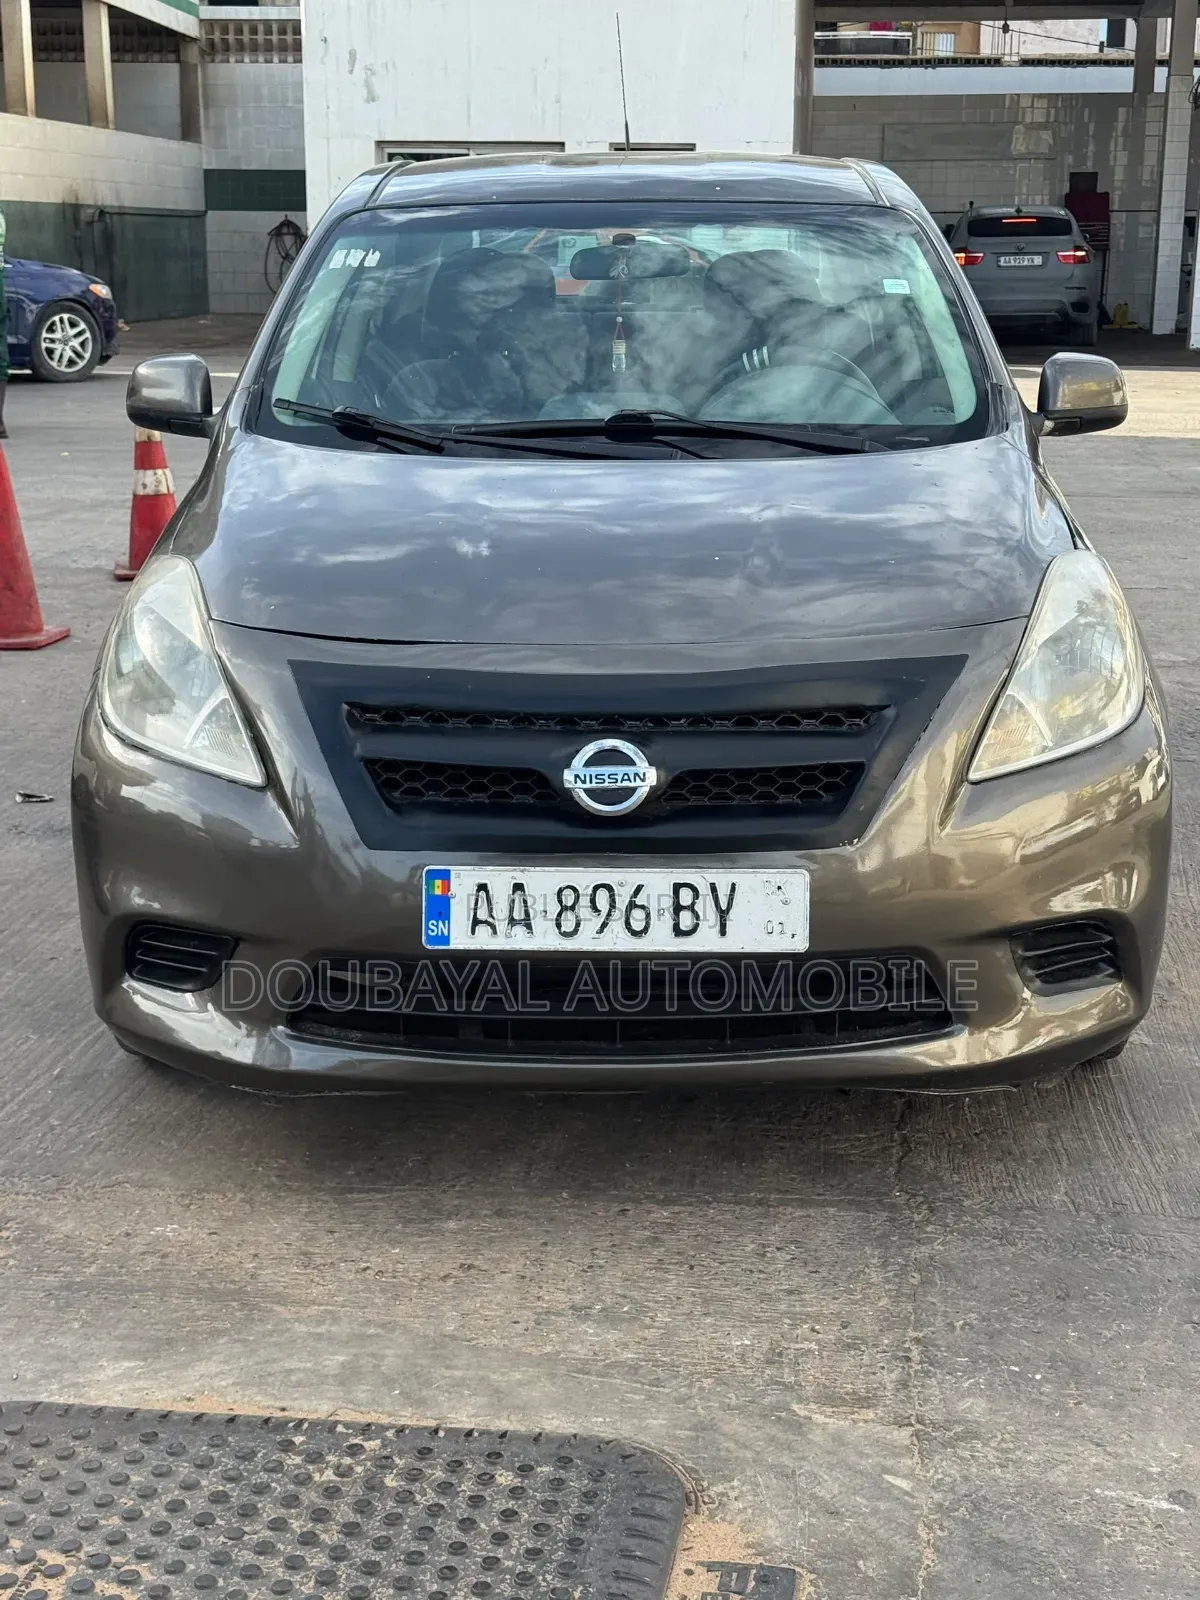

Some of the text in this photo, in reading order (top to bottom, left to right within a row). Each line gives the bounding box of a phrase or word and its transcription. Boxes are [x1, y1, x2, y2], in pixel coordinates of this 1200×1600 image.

[573, 772, 647, 785] NISSAN
[471, 881, 736, 938] AA 896 BY
[428, 920, 448, 935] SN
